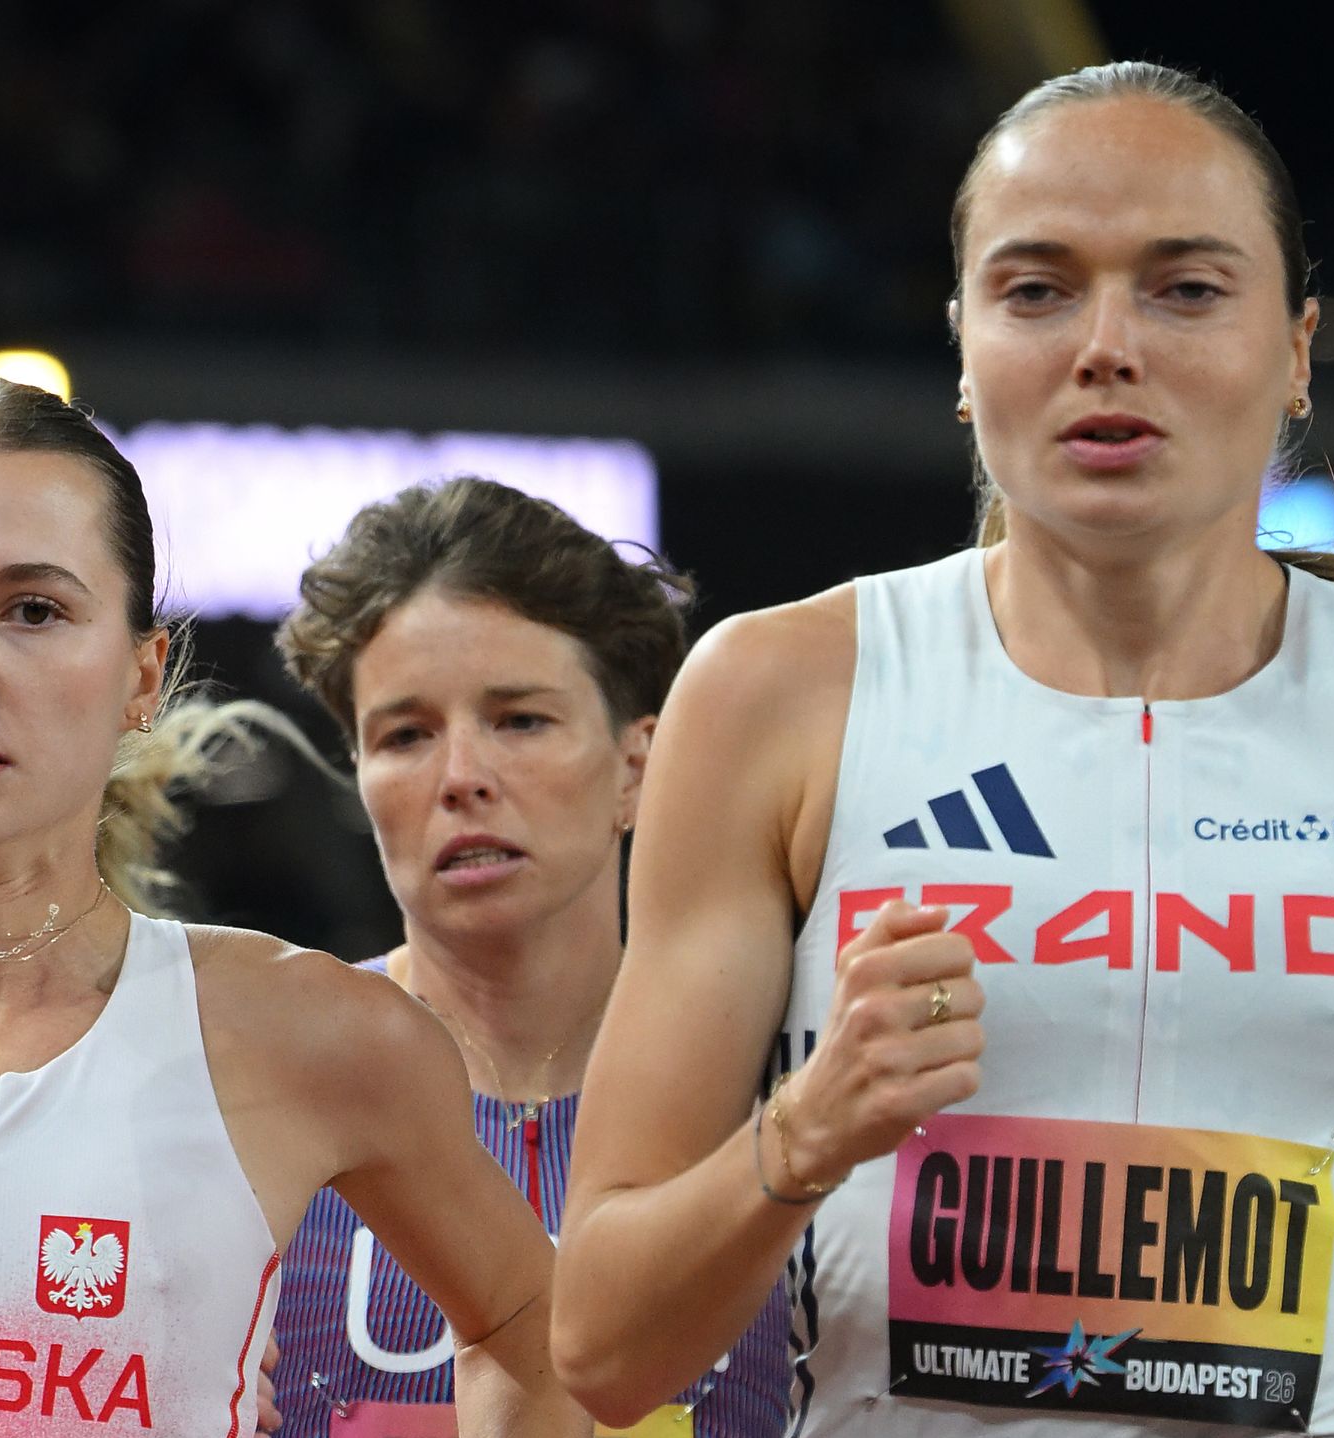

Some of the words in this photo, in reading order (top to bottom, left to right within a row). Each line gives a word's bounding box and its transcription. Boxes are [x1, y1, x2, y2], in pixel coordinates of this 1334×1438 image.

[1193, 815, 1293, 842] Crédit
[909, 1150, 1320, 1315] GUILLEMOT
[913, 1342, 1031, 1384] ULTIMATE
[1125, 1358, 1263, 1401] BUDAPEST
[1264, 1371, 1296, 1404] 26
